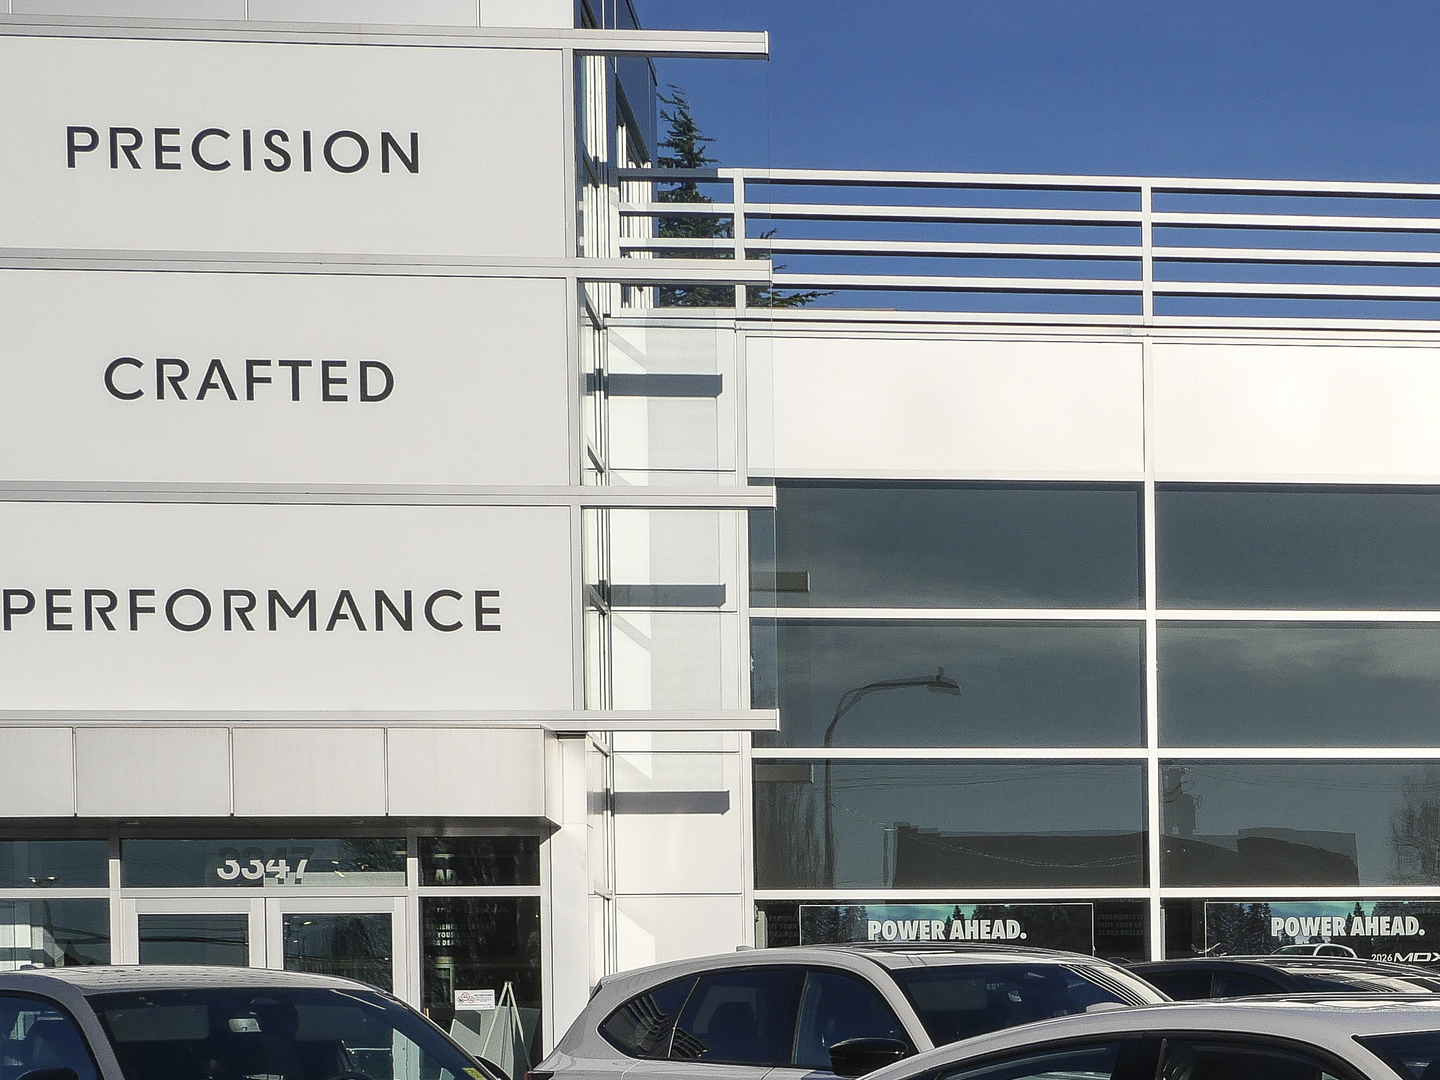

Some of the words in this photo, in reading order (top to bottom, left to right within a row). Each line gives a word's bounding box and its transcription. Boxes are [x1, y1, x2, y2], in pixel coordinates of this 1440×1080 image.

[66, 126, 420, 174] PRECISION
[104, 357, 395, 403] CRAFTED
[2, 588, 502, 632] PERFORMANCE
[216, 847, 314, 880] 3347
[867, 919, 945, 941] POWER
[949, 918, 1028, 940] AHEAD.
[1270, 916, 1347, 937] POWER
[1350, 916, 1426, 936] AHEAD.
[1371, 953, 1393, 962] 2026
